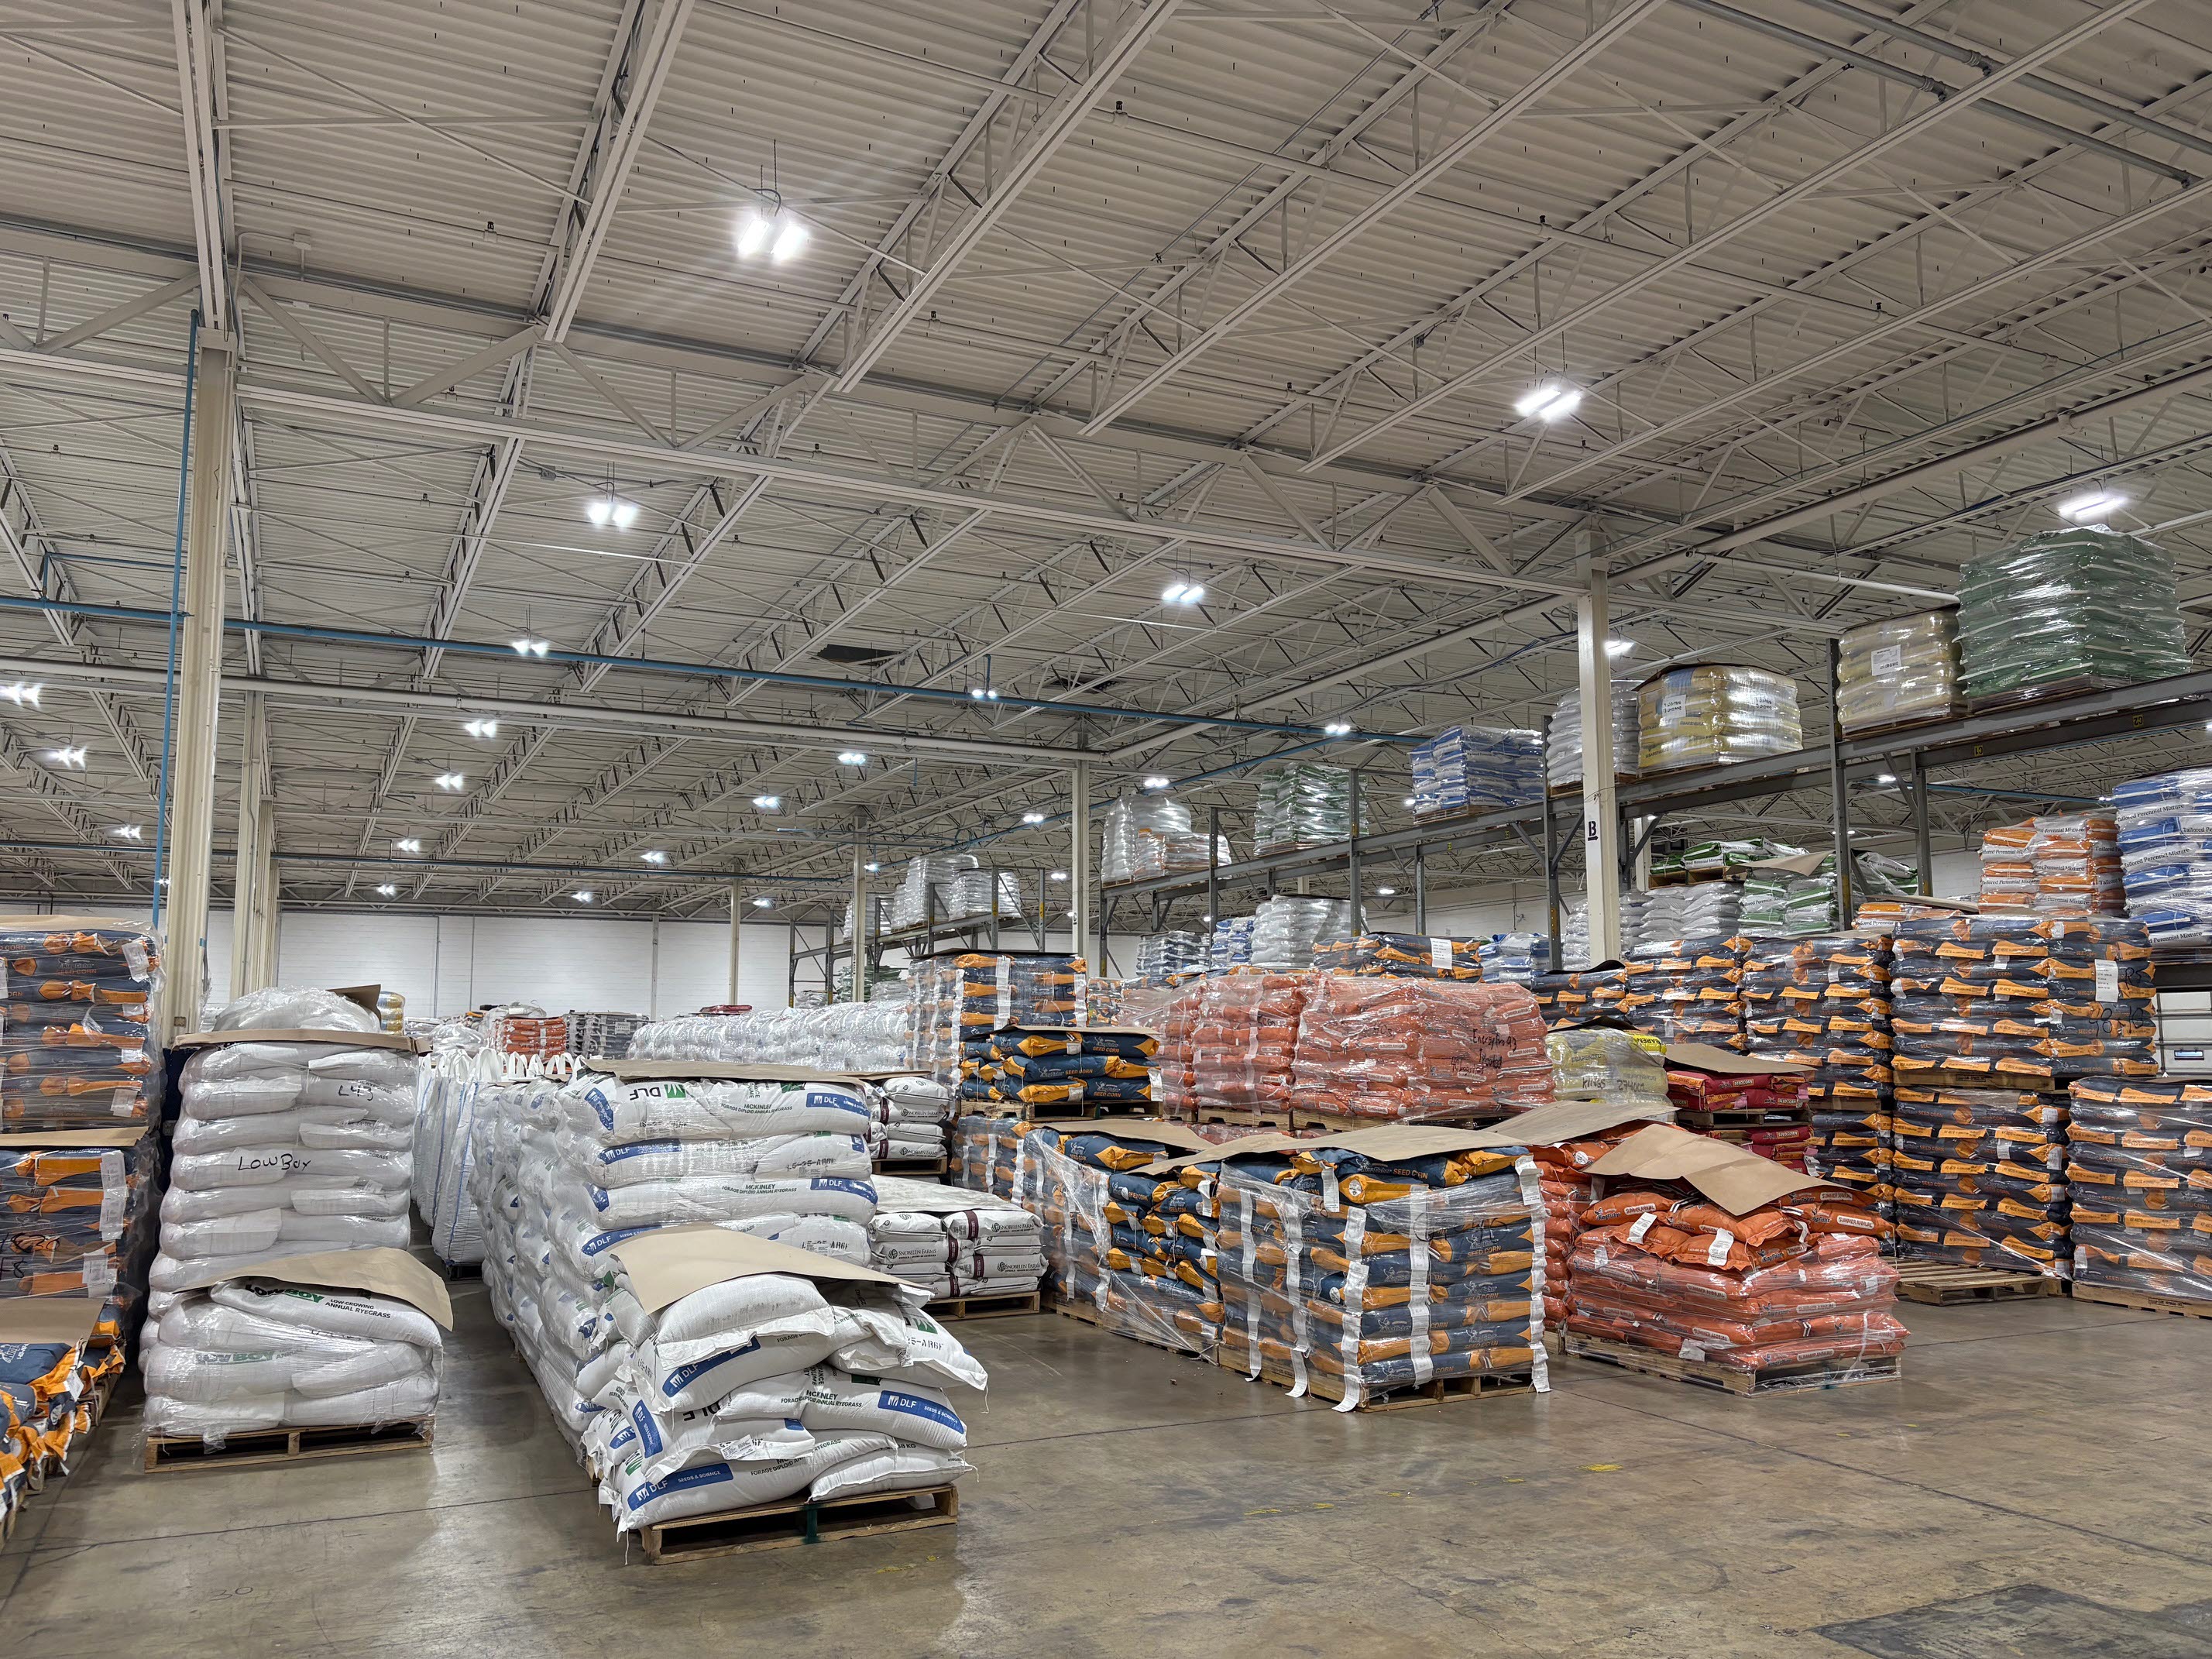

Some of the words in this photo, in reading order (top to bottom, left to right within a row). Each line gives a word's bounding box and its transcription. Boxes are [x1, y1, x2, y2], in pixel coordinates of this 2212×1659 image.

[2134, 716, 2143, 726] C2
[1975, 746, 1983, 756] C1
[2118, 813, 2136, 823] Tailored
[2137, 807, 2162, 817] Perennial
[2162, 804, 2184, 812] Mixture
[1589, 821, 1597, 836] B
[2124, 858, 2144, 868] Tailored
[2169, 848, 2190, 857] Mixture
[2153, 933, 2179, 943] Perennial
[2179, 931, 2203, 940] Mixture
[630, 1087, 661, 1101] DLF
[616, 1146, 630, 1156] DLF
[1856, 1219, 1873, 1228] ANNUAL
[596, 1235, 612, 1247] DLF
[1468, 1248, 1483, 1256] SEED
[1484, 1245, 1501, 1253] CORN
[325, 1301, 354, 1312] ANNUAL
[355, 1305, 391, 1319] RYEGRASS
[900, 1398, 917, 1408] DLF
[924, 1405, 937, 1414] SEEDS
[750, 1467, 773, 1476] FORAGE
[650, 1480, 668, 1492] DLF
